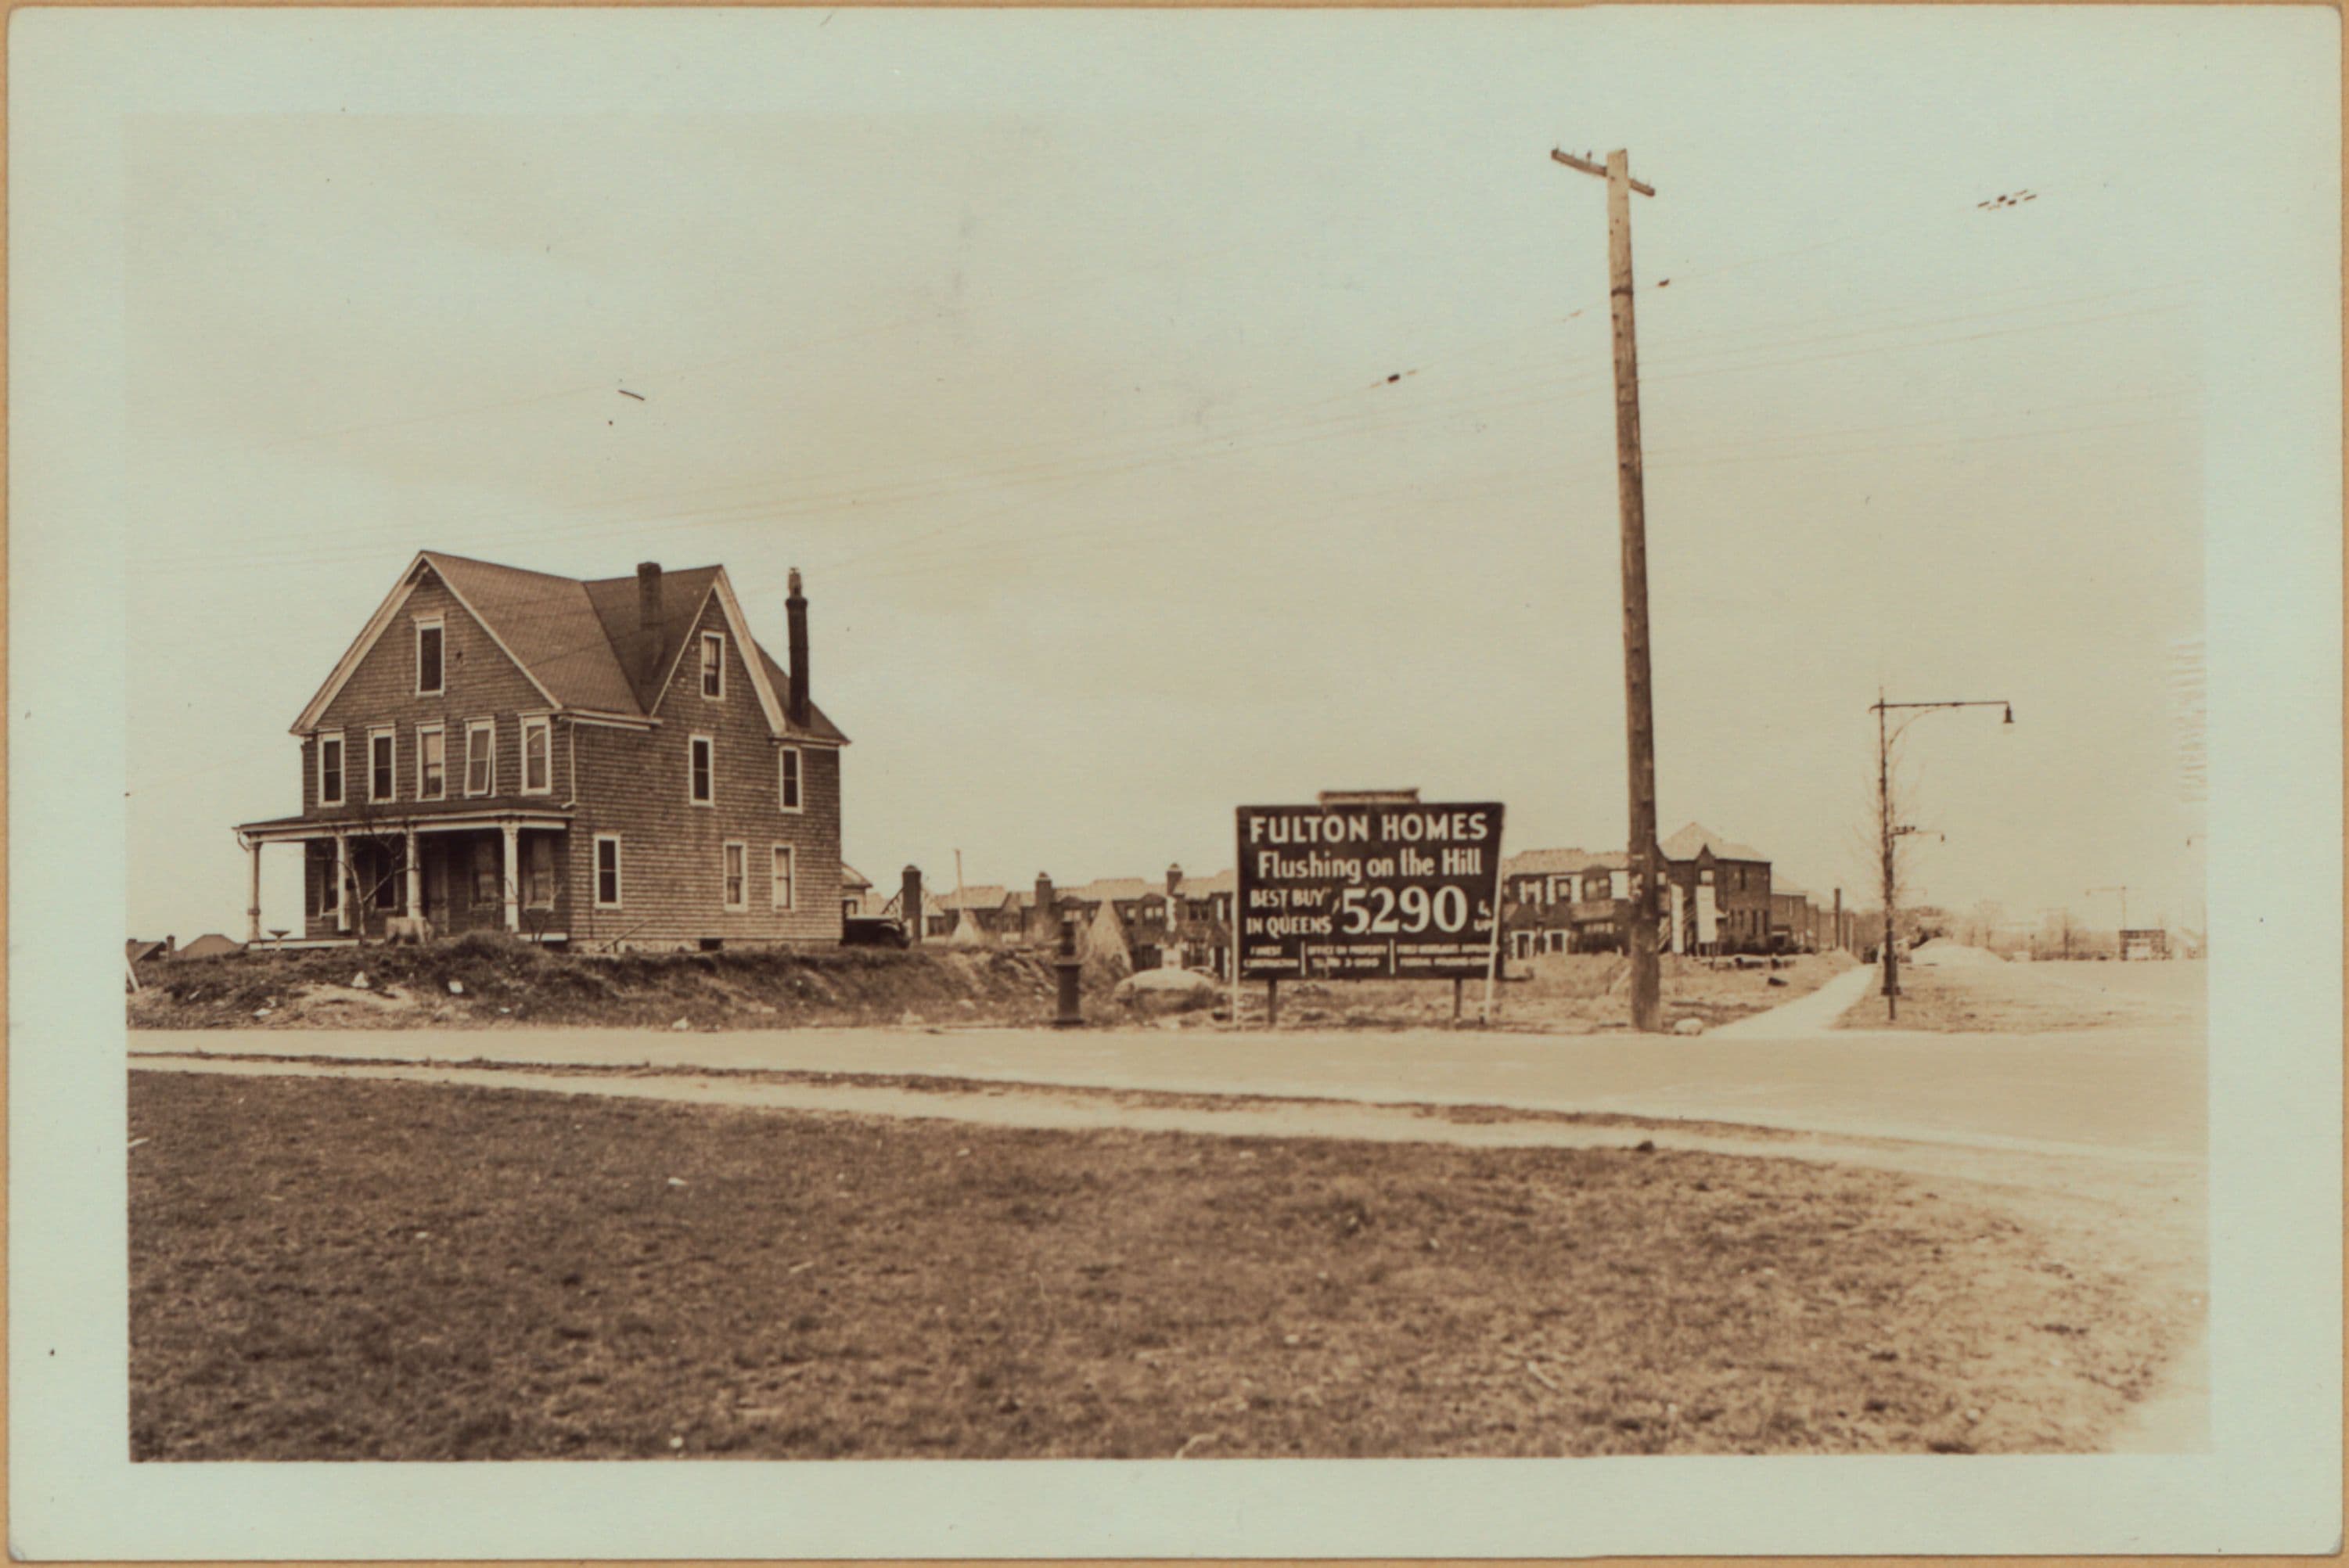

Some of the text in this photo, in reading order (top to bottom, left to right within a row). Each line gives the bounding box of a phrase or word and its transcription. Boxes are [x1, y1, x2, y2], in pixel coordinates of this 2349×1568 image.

[1250, 813, 1488, 843] FULTON HOMES
[1257, 847, 1482, 884] Flushing on the Hill
[1250, 890, 1290, 908] BEST
[1246, 915, 1333, 938] IN QUEENS
